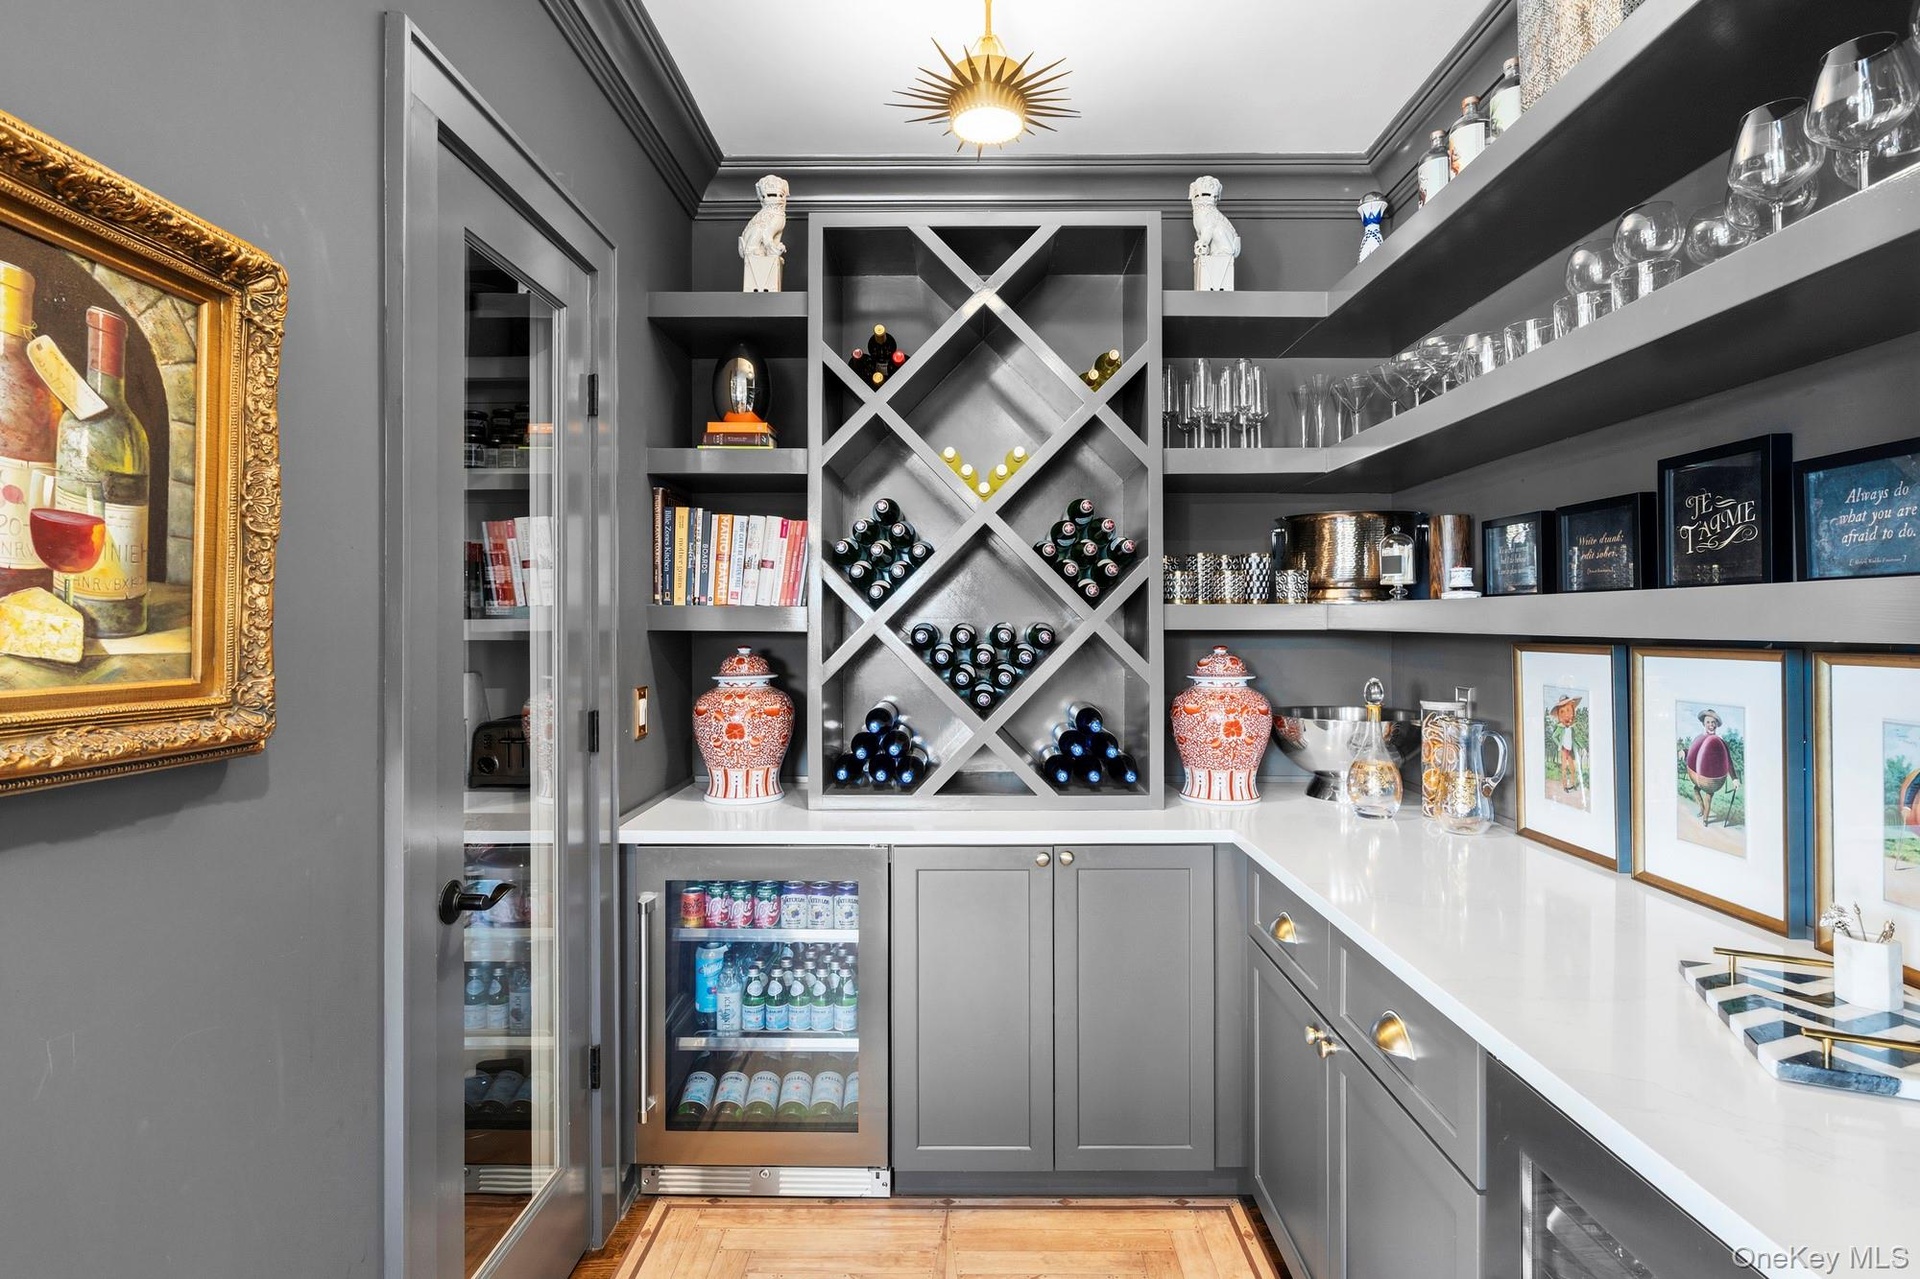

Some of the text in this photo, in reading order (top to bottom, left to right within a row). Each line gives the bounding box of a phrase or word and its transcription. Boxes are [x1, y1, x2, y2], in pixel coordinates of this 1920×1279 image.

[1844, 480, 1909, 505] Always do
[1834, 505, 1918, 526] what you are
[664, 525, 672, 546] Zones
[720, 515, 730, 553] MARIO
[1576, 534, 1597, 546] Write
[1841, 522, 1916, 547] afraid to do.
[664, 546, 672, 572] Kitchen
[701, 543, 709, 574] BOARDS
